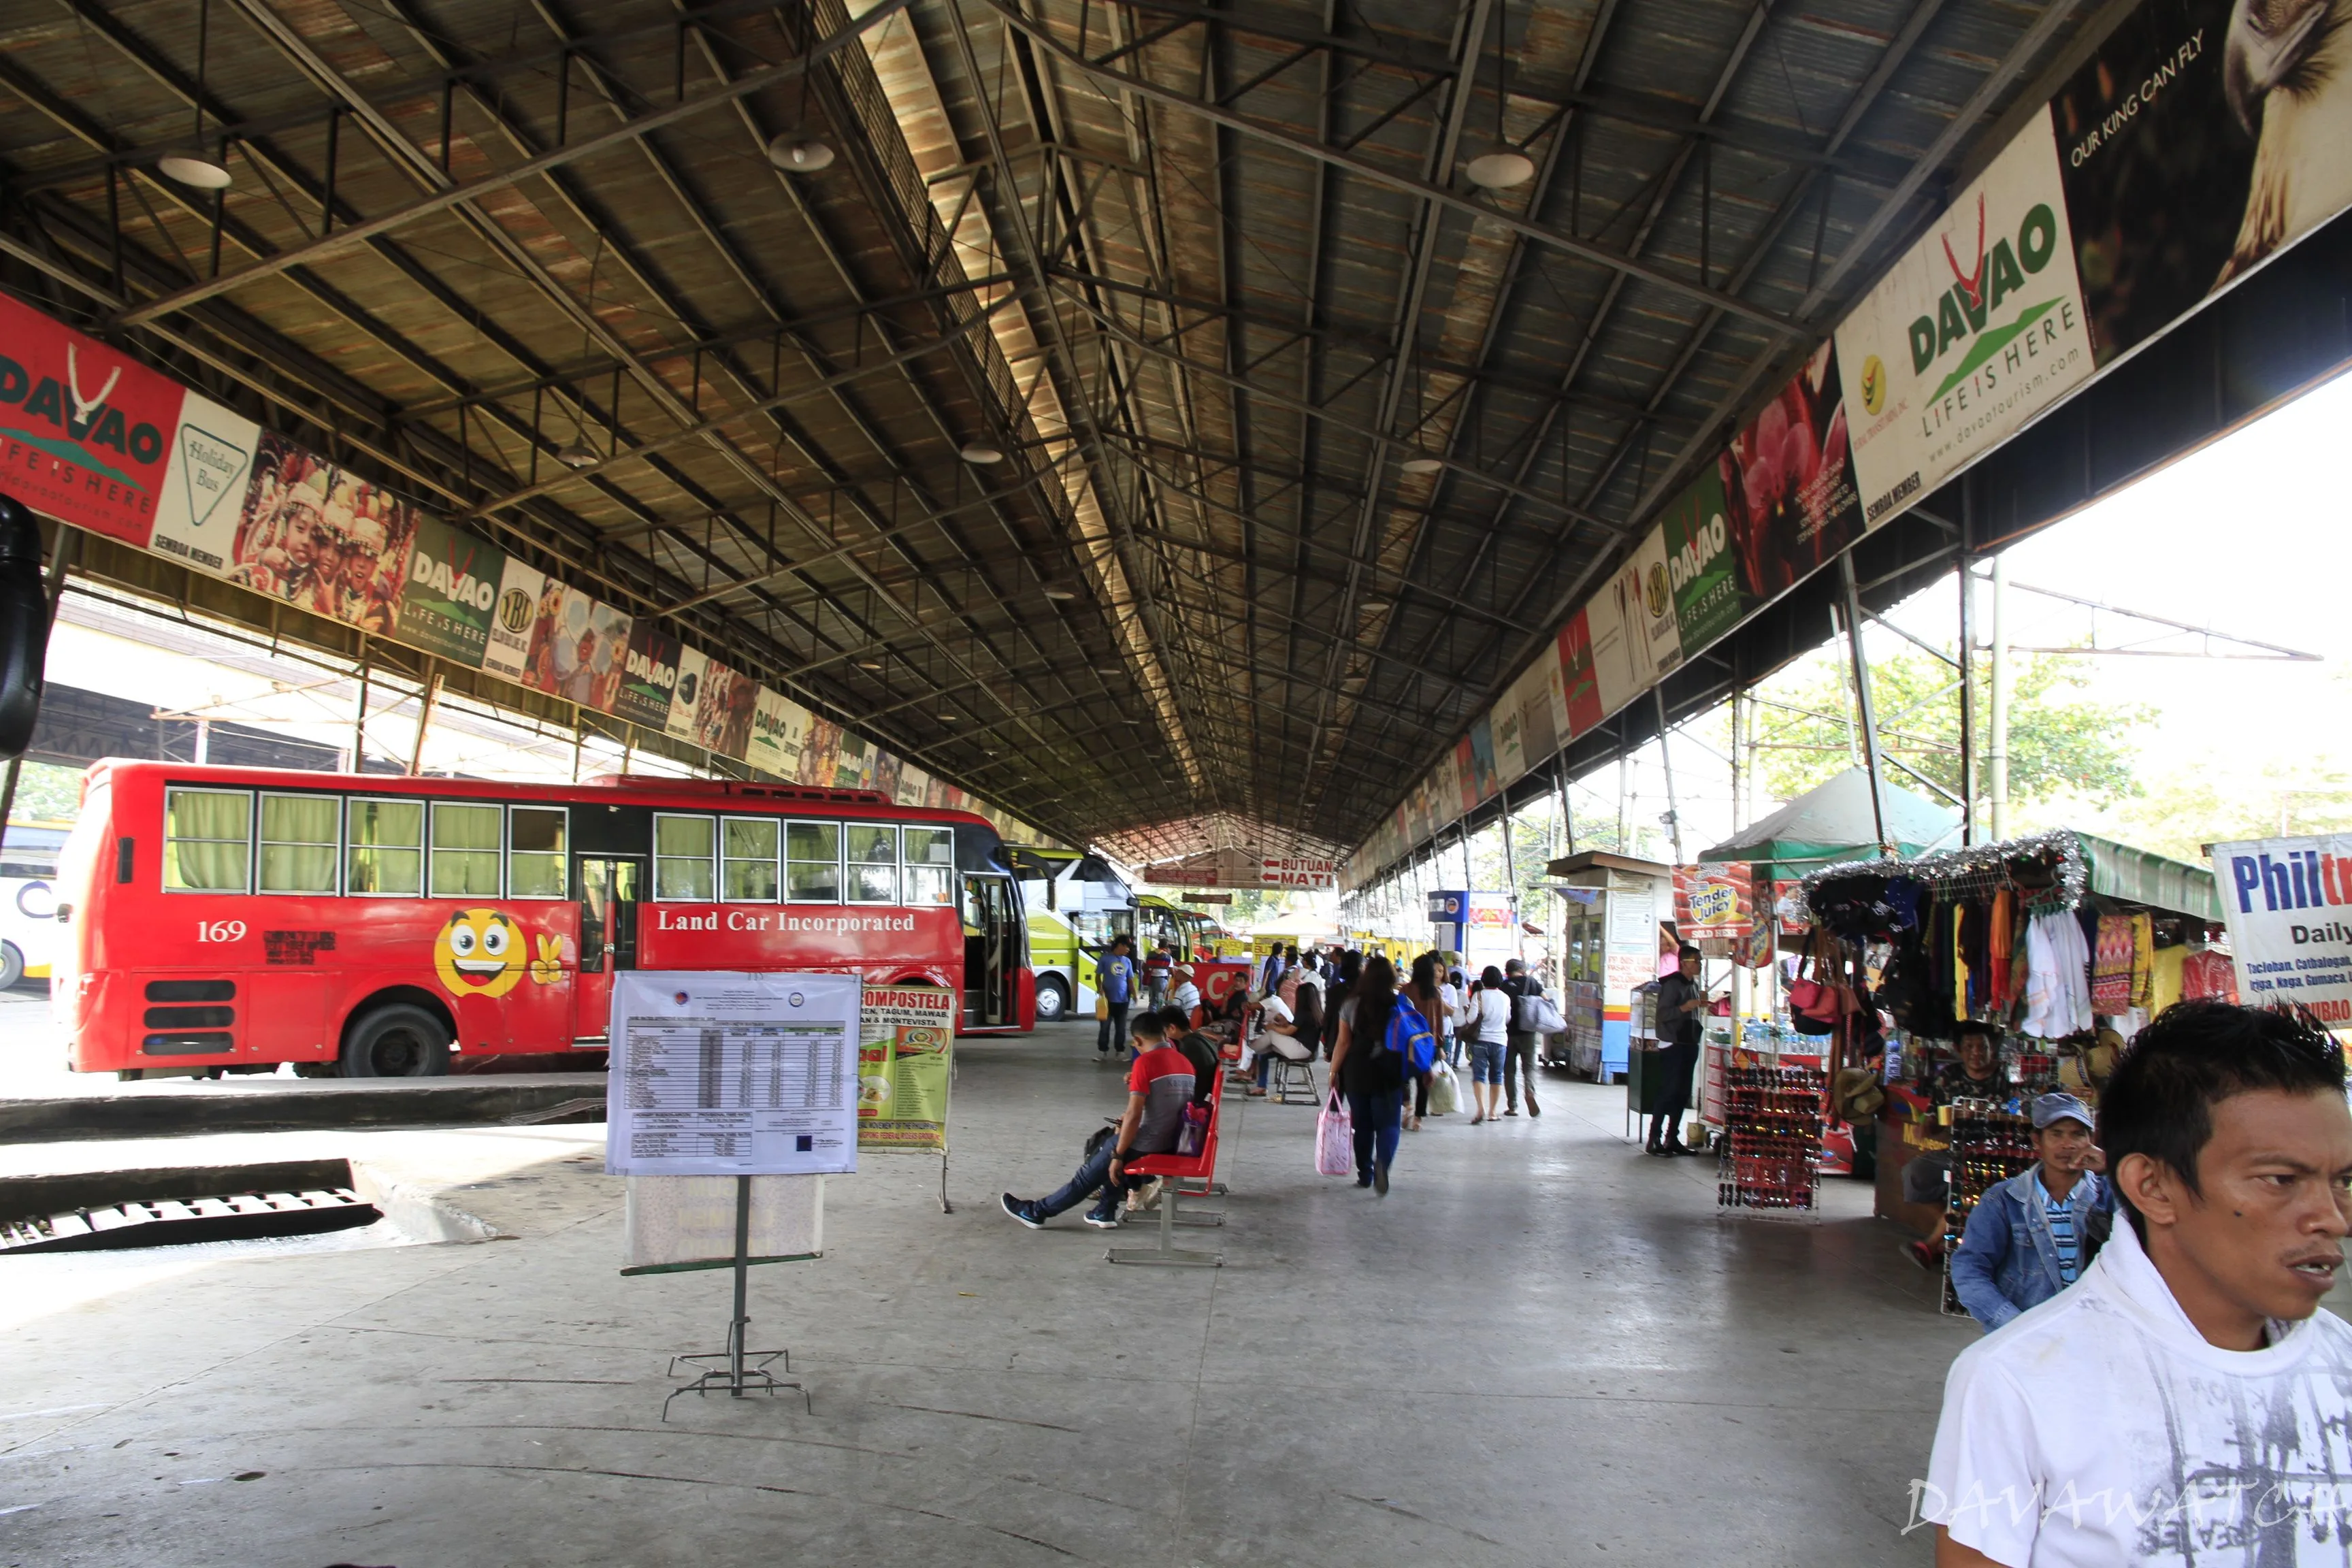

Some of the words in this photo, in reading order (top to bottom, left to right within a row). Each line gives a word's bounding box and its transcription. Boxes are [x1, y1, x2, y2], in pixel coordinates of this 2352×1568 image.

[2071, 131, 2102, 167] OUR
[2102, 94, 2138, 140] KING
[2140, 58, 2176, 102] CAN
[2178, 28, 2204, 69] FLY
[1908, 203, 2056, 377] DAVAO
[1922, 386, 1967, 437] LIFE
[1974, 365, 1997, 397] IS
[2004, 302, 2075, 373] HERE
[0, 354, 163, 464] DAVAO
[1929, 348, 2079, 463] www.davaotourism.com
[189, 441, 236, 478] Holiday
[50, 460, 75, 483] IS
[85, 474, 151, 514] HERE
[196, 468, 219, 492] Bus
[1867, 491, 1893, 523] SEMBOA
[1893, 471, 1921, 505] MEMBER
[190, 547, 224, 570] MEMBER
[1669, 513, 1725, 592] DAVAO
[412, 551, 495, 611] DAVAO
[1679, 605, 1697, 632] LIFE
[1710, 575, 1735, 607] HERE
[404, 602, 436, 625] LIFE
[453, 621, 487, 645] HERE
[625, 649, 676, 689] DAVAO
[619, 687, 639, 703] LIFE
[649, 699, 670, 715] HERE
[755, 708, 786, 739] DAVAO
[1281, 858, 1333, 872] BUTUAN
[1281, 872, 1333, 885] MATI
[1690, 887, 1735, 909] Tender
[1698, 900, 1731, 921] Juicy
[197, 920, 247, 943] 169
[657, 911, 718, 930] Land
[728, 911, 770, 931] Car
[777, 912, 915, 936] Incorporated
[1691, 930, 1714, 938] SOLD
[1714, 929, 1738, 937] HERE
[862, 991, 949, 1009] OMPOSTELA
[881, 1009, 913, 1017] TAGUM,
[882, 1017, 937, 1026] MONTEVISTA
